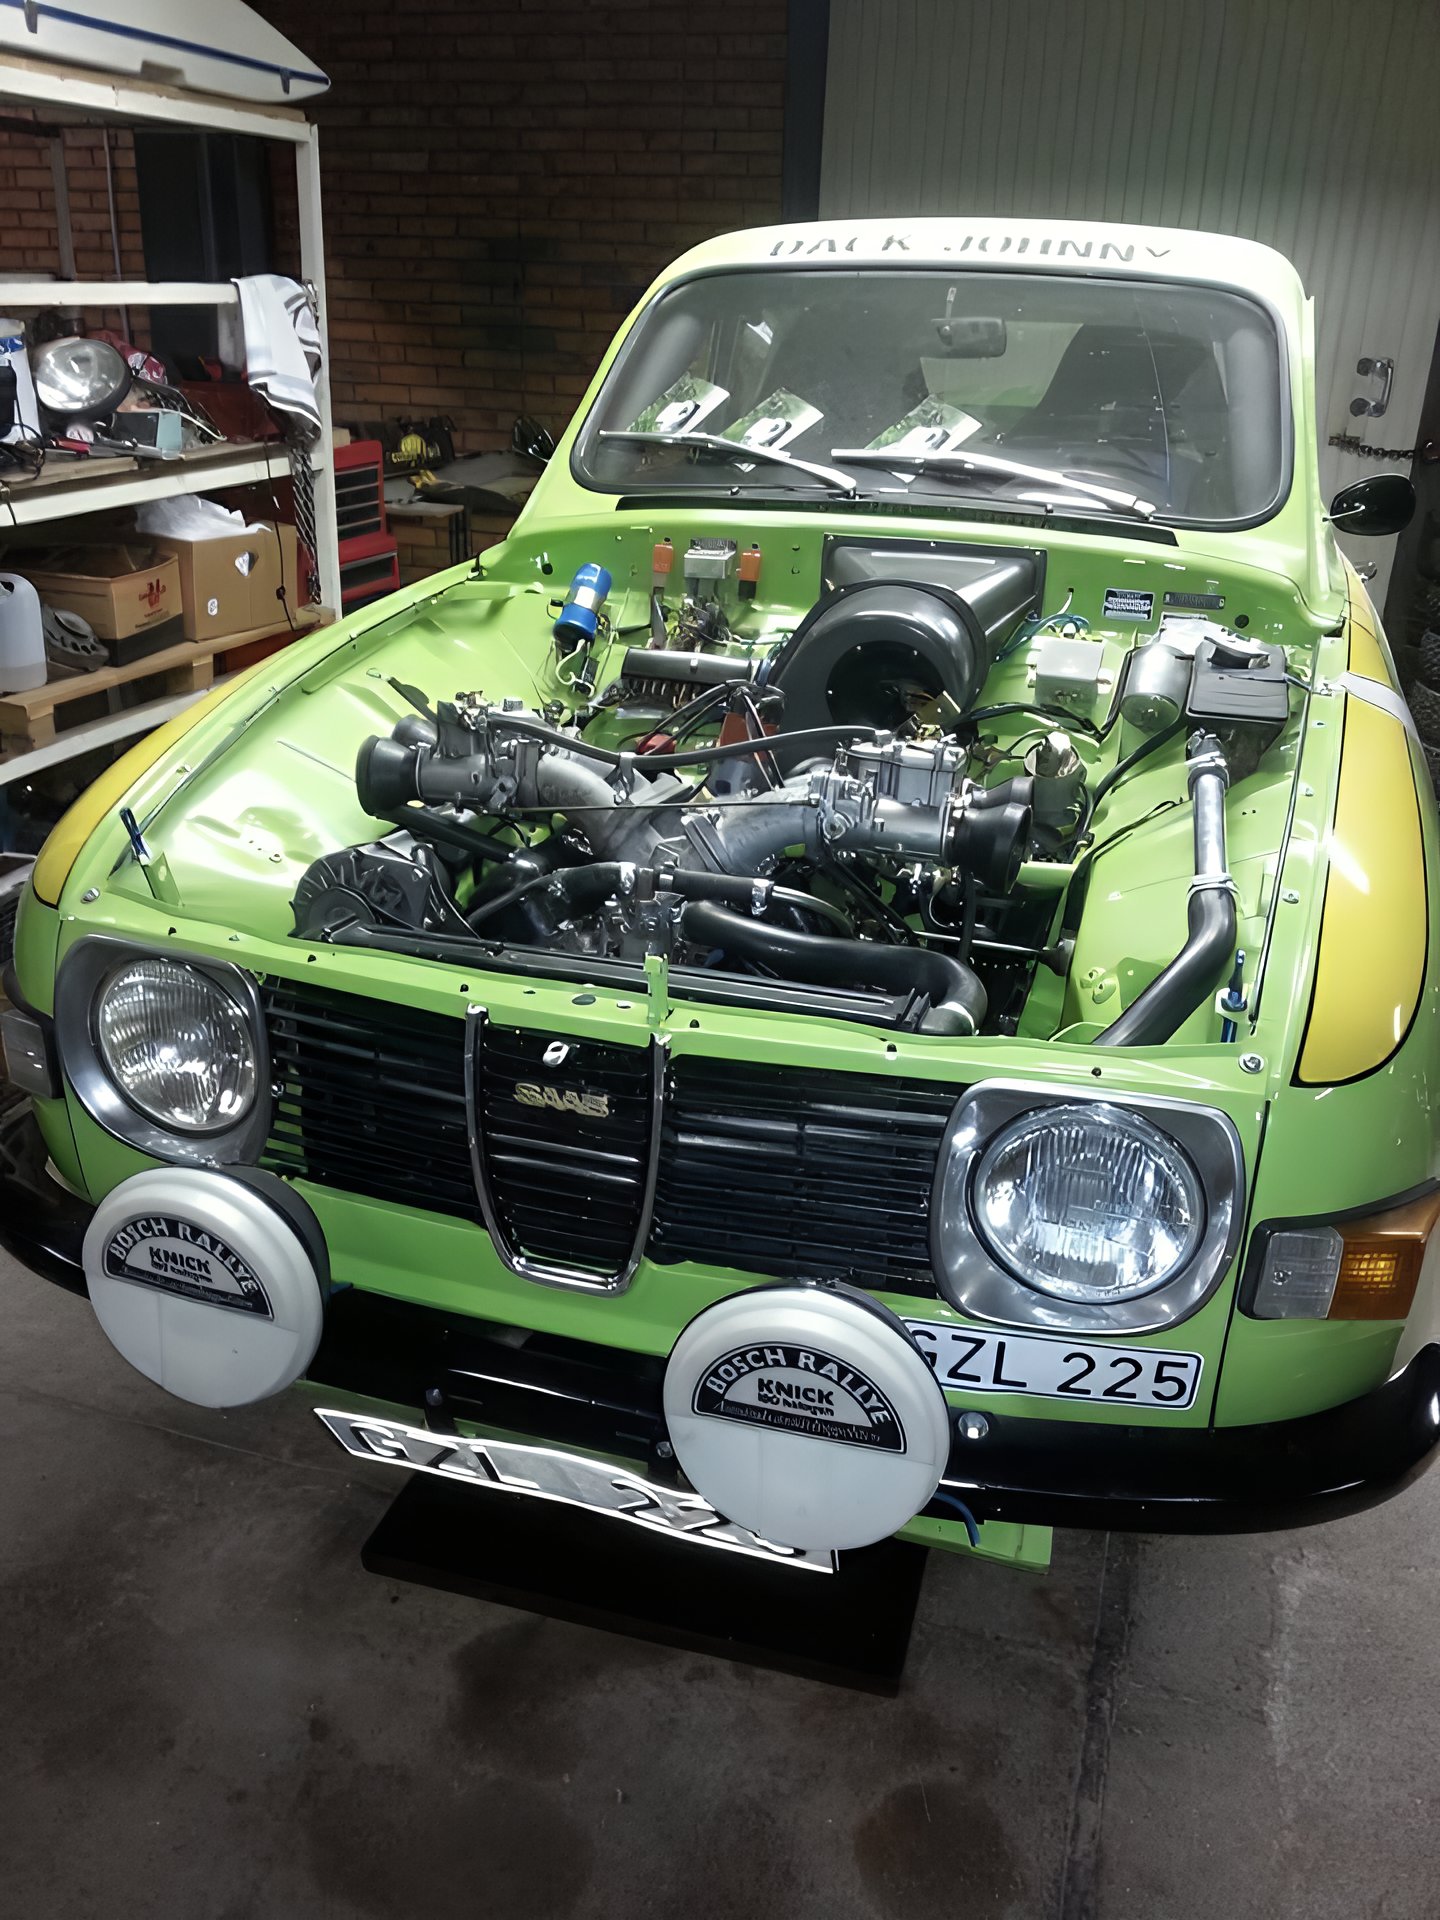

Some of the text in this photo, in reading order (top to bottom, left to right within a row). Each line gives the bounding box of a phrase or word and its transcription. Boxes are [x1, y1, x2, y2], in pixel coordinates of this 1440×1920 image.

[109, 1217, 170, 1261] BOSCH
[149, 1246, 211, 1275] KNICK
[705, 1348, 787, 1395] BOSCH
[798, 1351, 892, 1425] RALLYE
[757, 1377, 835, 1407] KNICK
[1056, 1351, 1189, 1402] 225
[350, 1421, 541, 1490] GZL
